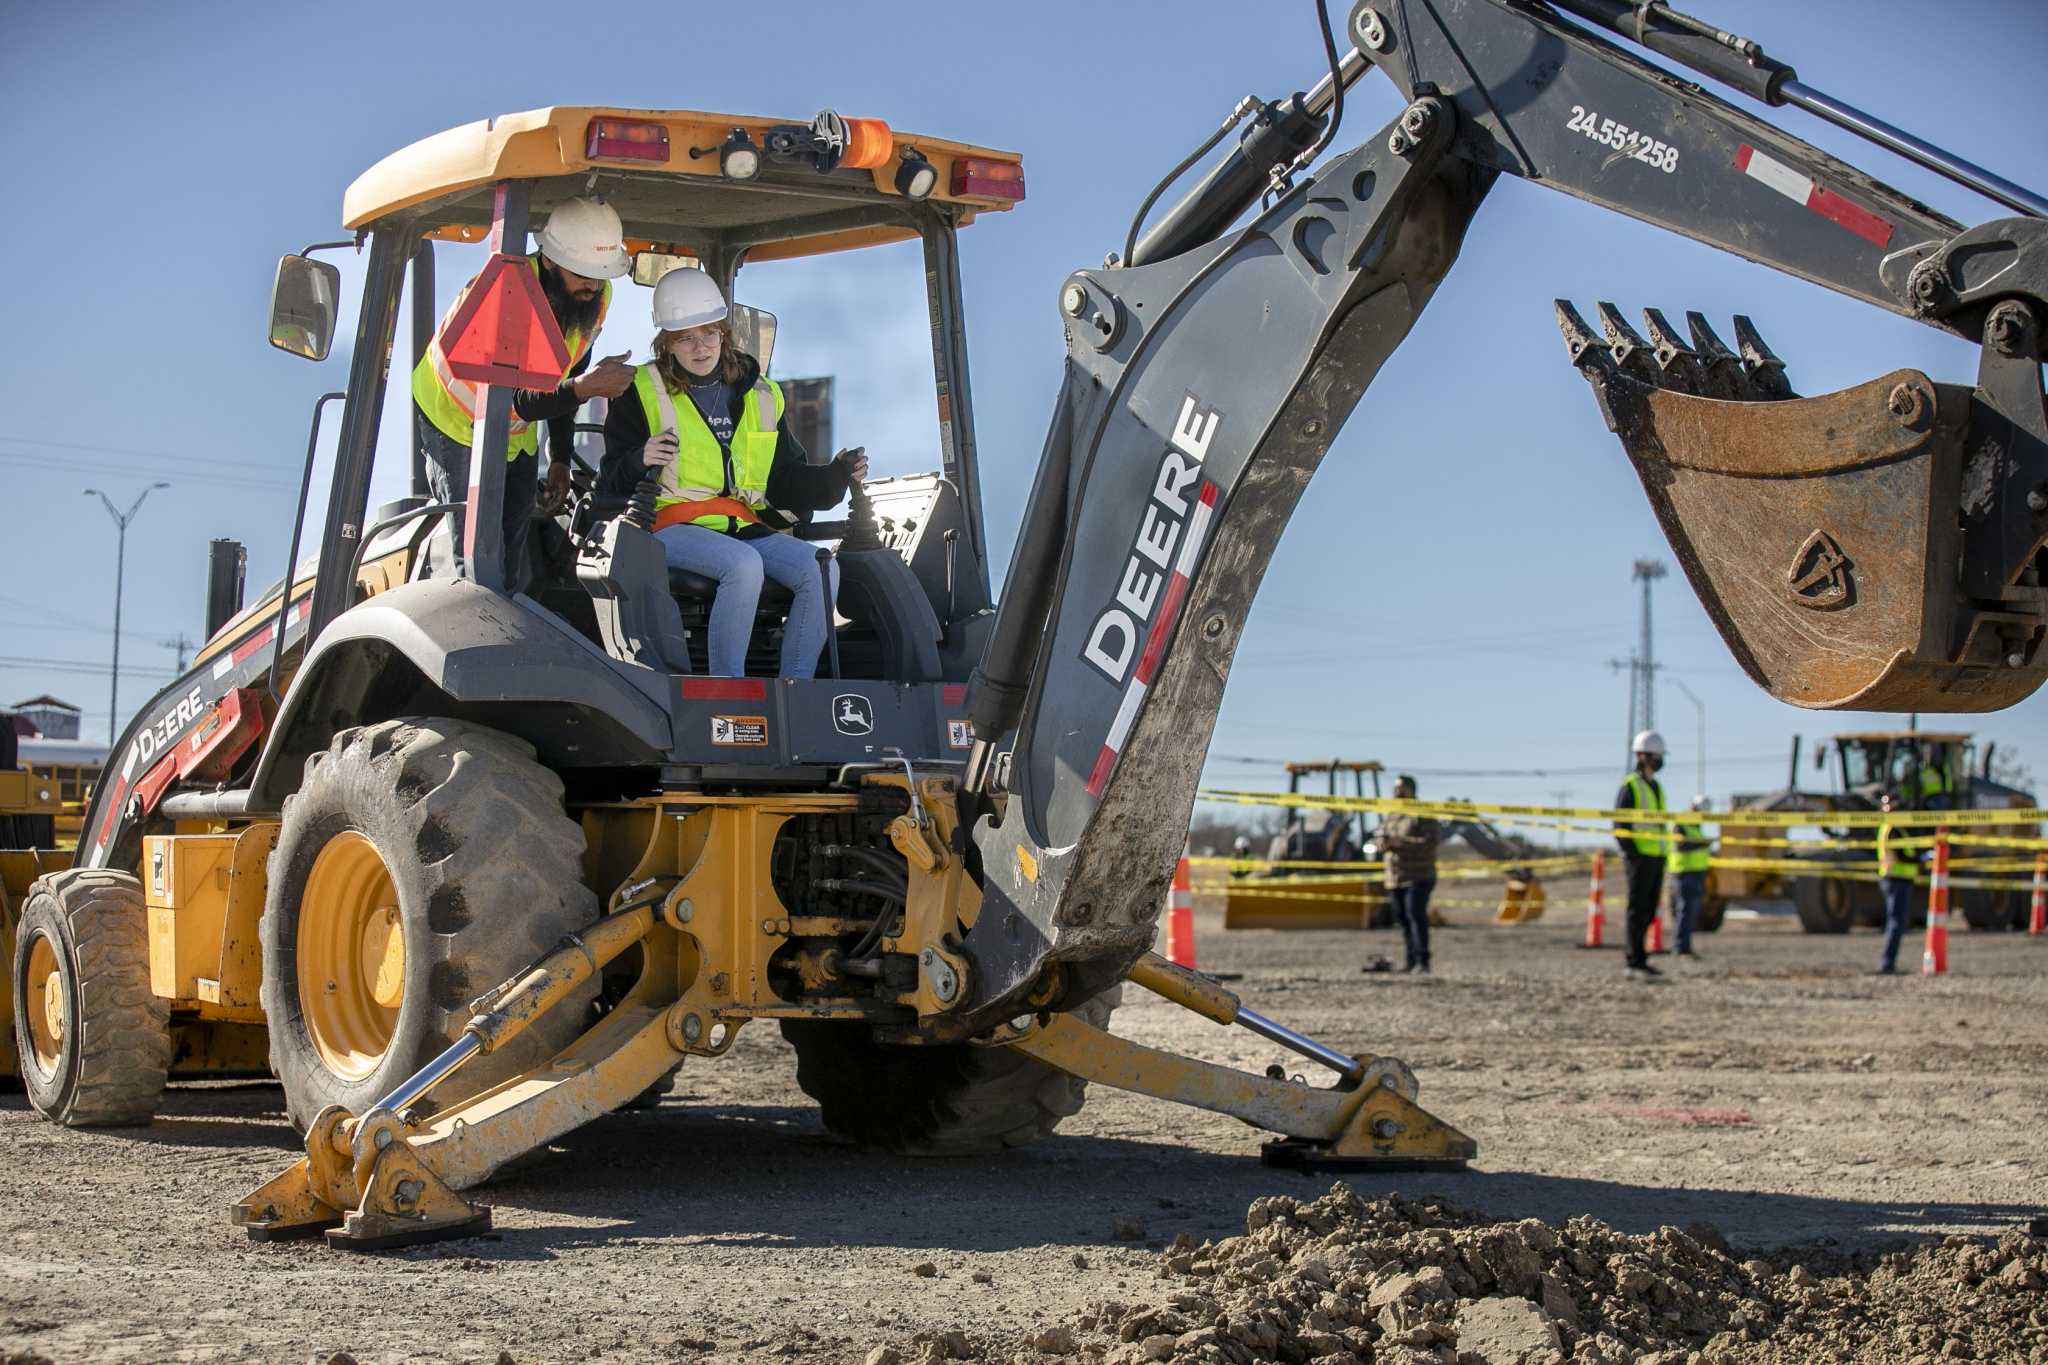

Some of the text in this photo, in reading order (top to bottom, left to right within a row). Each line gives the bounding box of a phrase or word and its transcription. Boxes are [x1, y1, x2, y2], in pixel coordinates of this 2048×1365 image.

[1566, 105, 1679, 174] 24.551258
[1084, 395, 1220, 683] DEERE
[138, 686, 204, 764] DEERE
